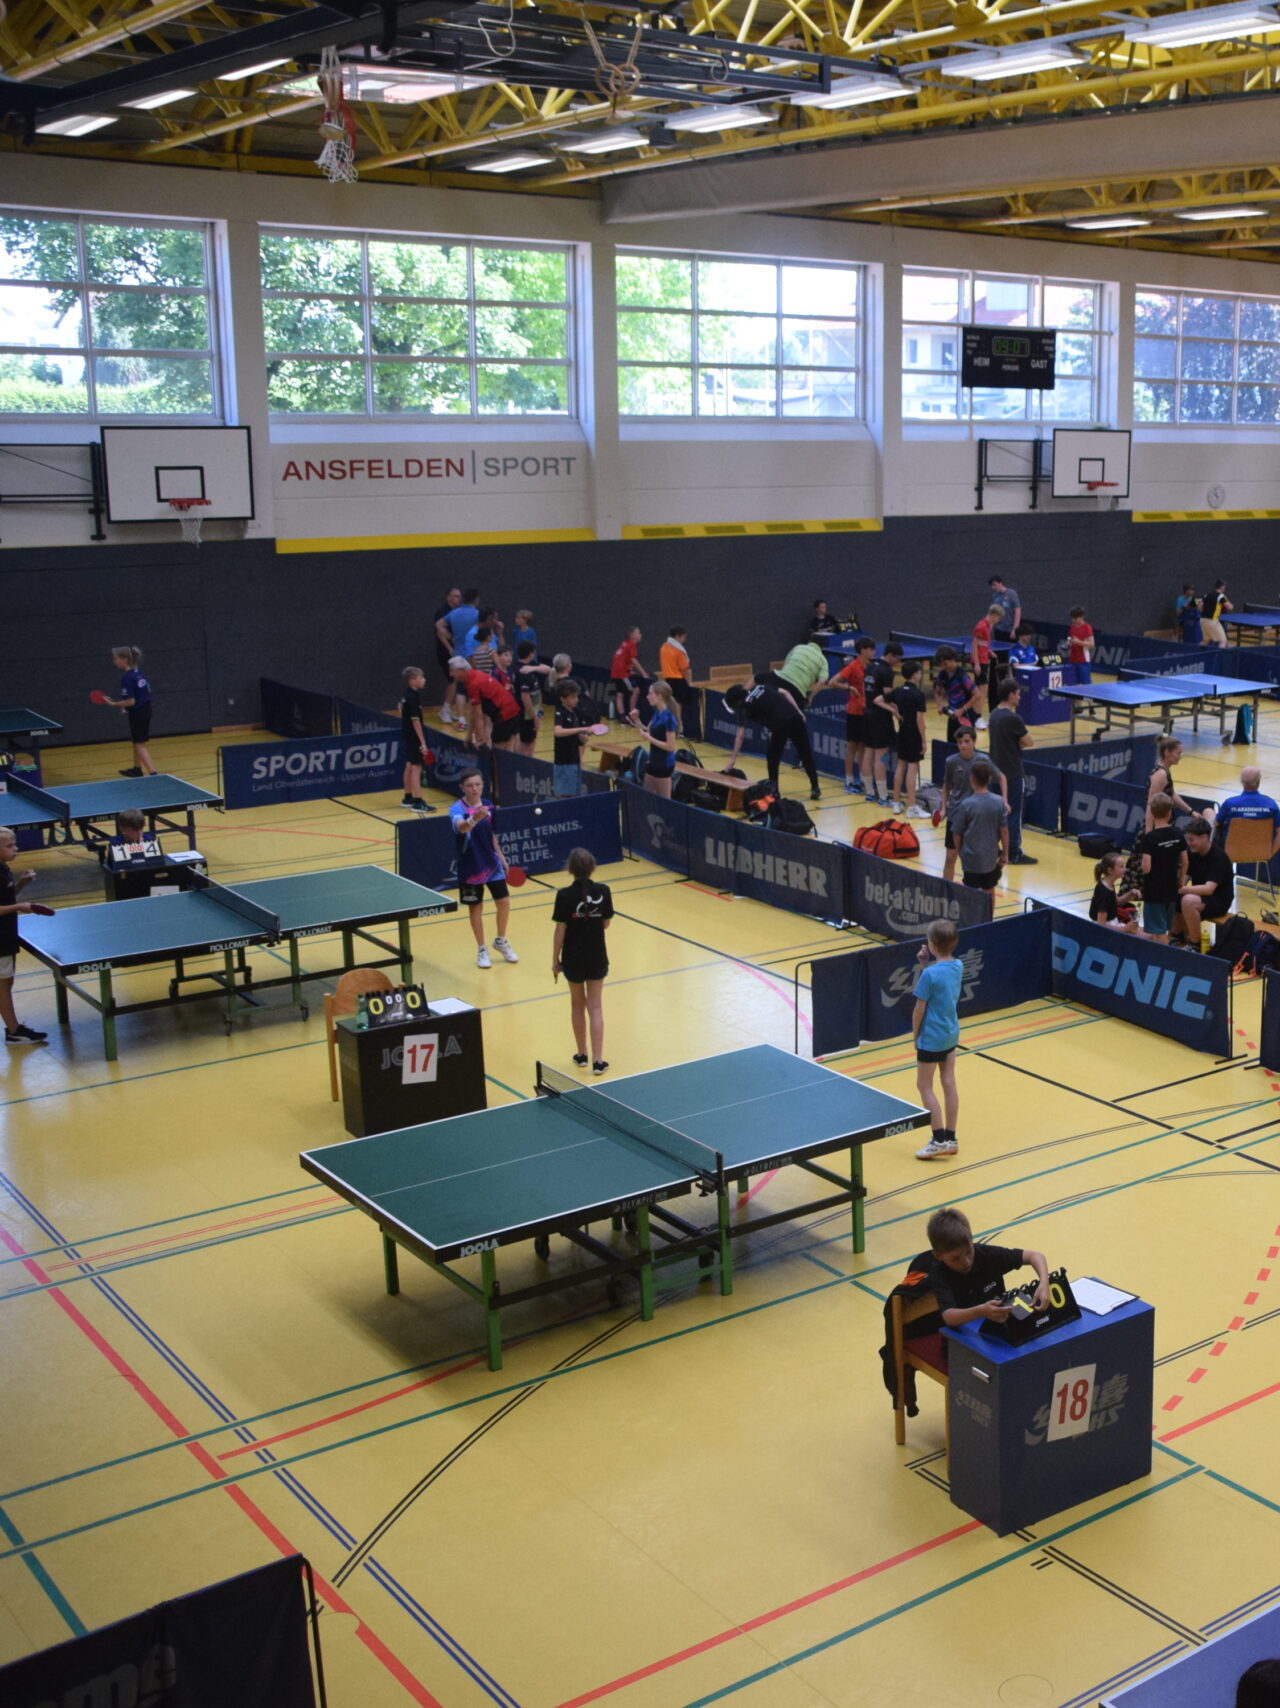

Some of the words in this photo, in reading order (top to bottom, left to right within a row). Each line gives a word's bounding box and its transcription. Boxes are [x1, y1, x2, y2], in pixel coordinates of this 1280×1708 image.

[282, 457, 465, 481] ANSFELDEN
[483, 456, 577, 477] SPORT
[1051, 676, 1061, 689] 12
[252, 749, 342, 780] SPORT
[534, 820, 583, 837] TENNIS.
[146, 843, 157, 855] 4
[502, 843, 519, 855] OR
[522, 838, 547, 852] ALL.
[523, 849, 554, 863] LIFE.
[418, 906, 446, 918] JOOLA
[293, 925, 333, 939] ROLLOMAT
[209, 938, 250, 952] ROLLOMAT
[78, 961, 112, 974] JOOLA
[1051, 931, 1212, 1020] DONIC
[368, 998, 384, 1015] 0
[406, 991, 421, 1009] 0
[407, 1043, 435, 1074] 17
[884, 1121, 914, 1138] JOOLA
[460, 1238, 500, 1258] JOOLA
[1049, 1283, 1066, 1309] 0
[1056, 1378, 1089, 1425] 18
